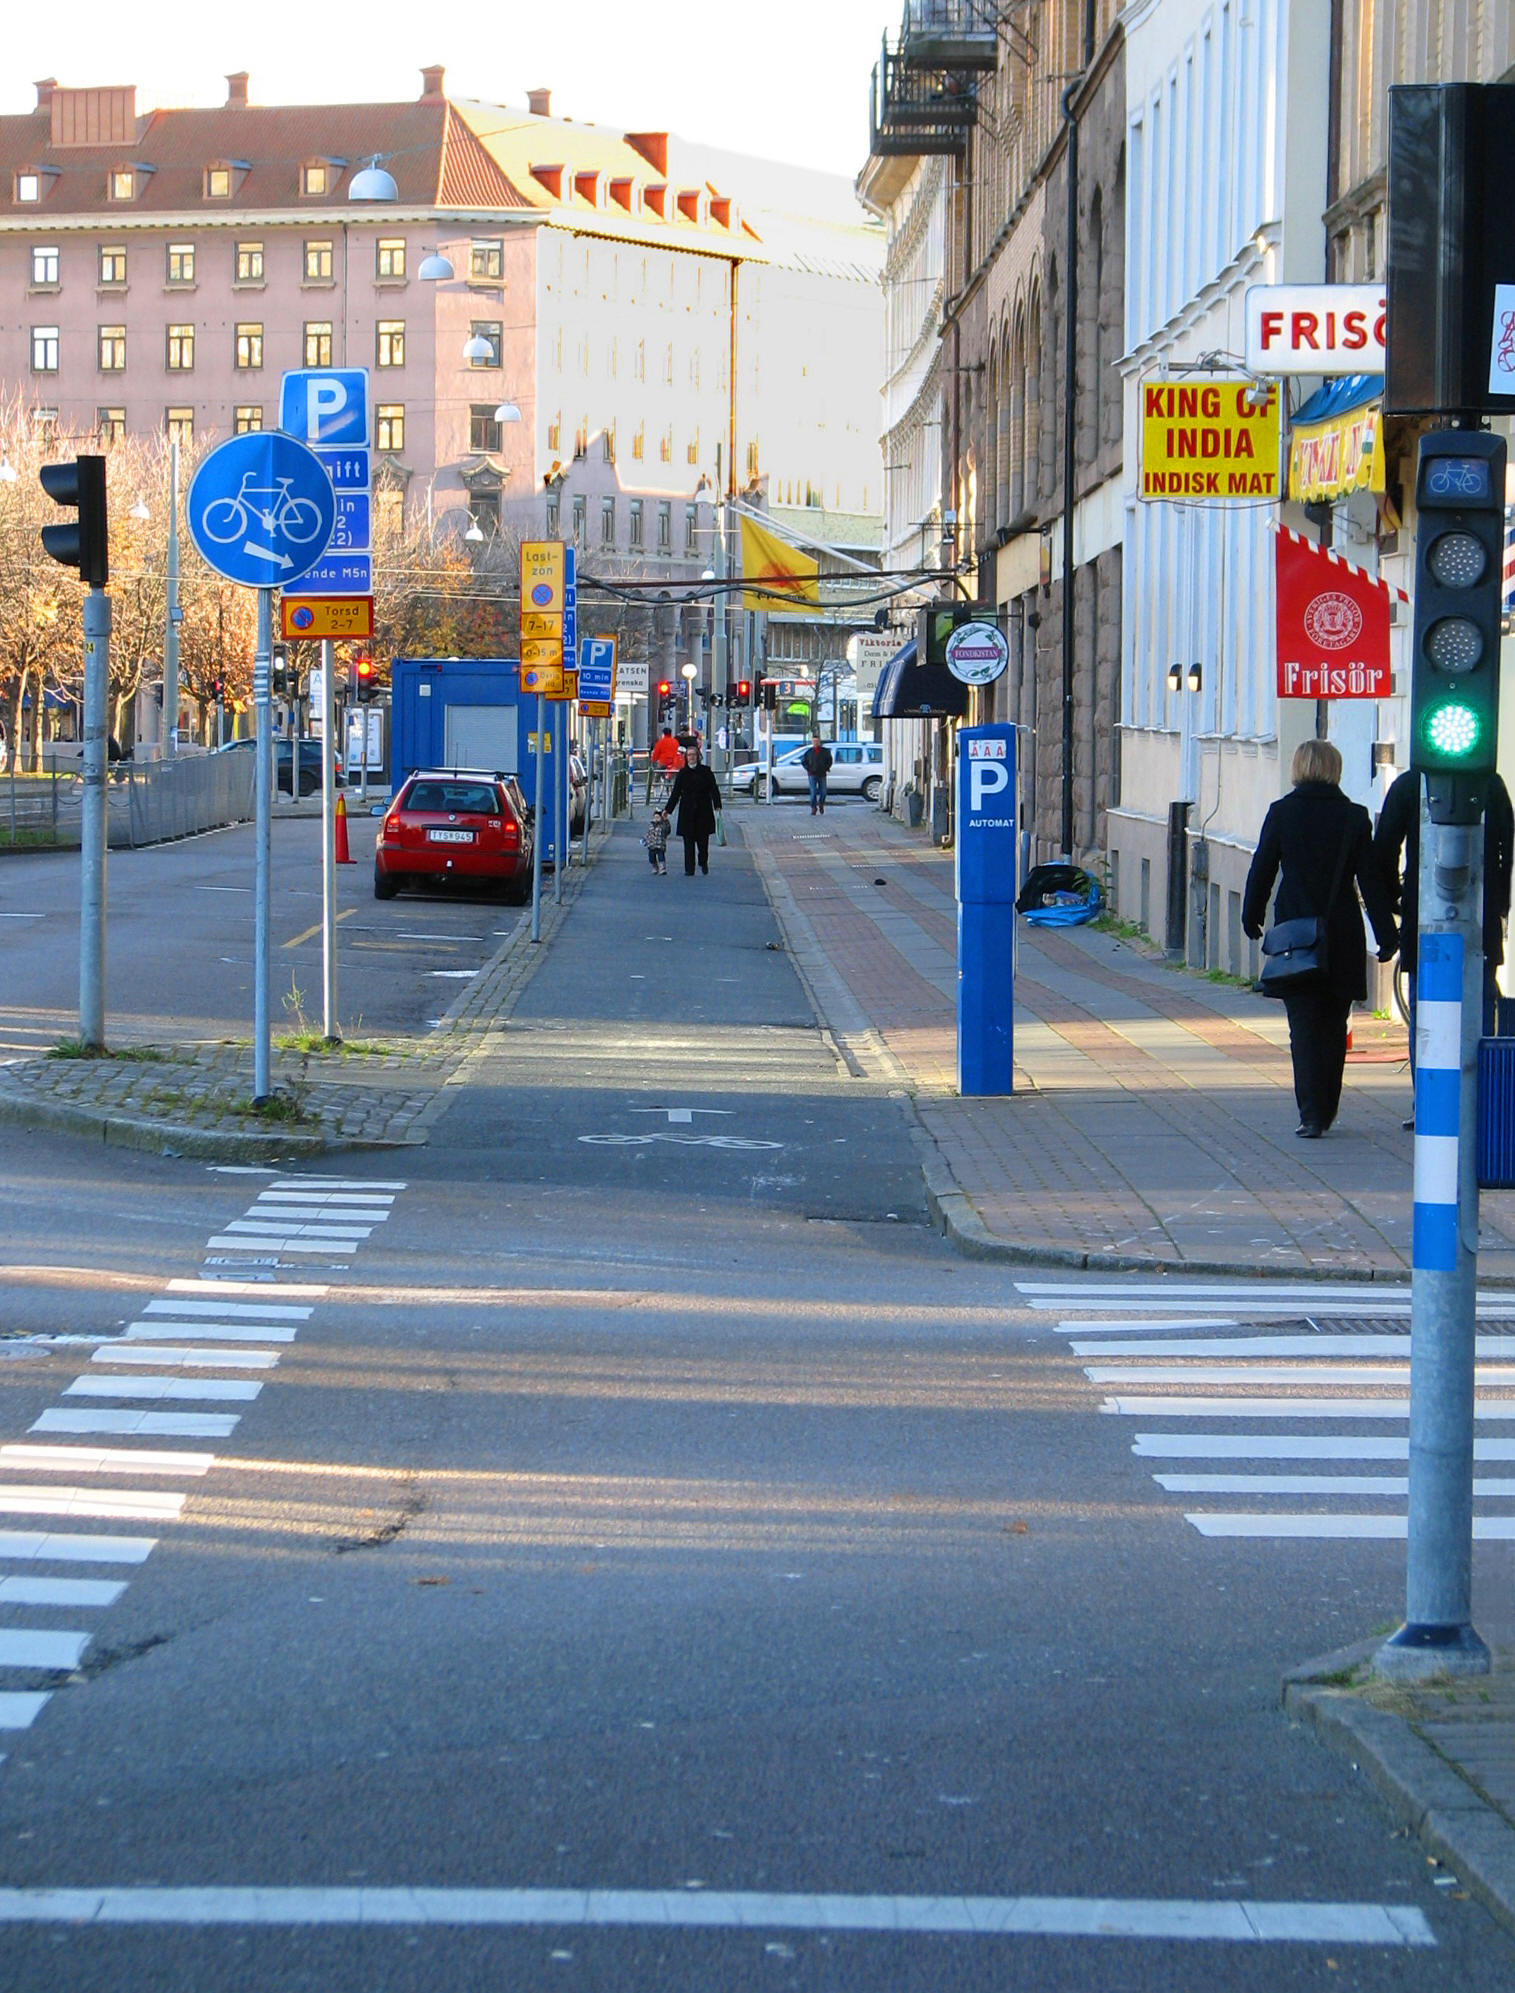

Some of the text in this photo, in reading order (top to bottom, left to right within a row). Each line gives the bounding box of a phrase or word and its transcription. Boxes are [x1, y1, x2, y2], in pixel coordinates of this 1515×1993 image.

[307, 378, 347, 439] P
[1146, 387, 1221, 418] KING
[1166, 428, 1255, 458] INDIA
[1144, 472, 1275, 494] INDISK MAT
[531, 567, 553, 576] zon
[325, 606, 359, 616] Torsd
[330, 620, 352, 630] 2-7
[590, 643, 606, 665] P
[582, 672, 591, 680] 10
[1284, 661, 1383, 695] Frisör
[970, 761, 1009, 811] P
[969, 819, 1015, 828] AUTOMAT
[454, 832, 473, 841] 945
